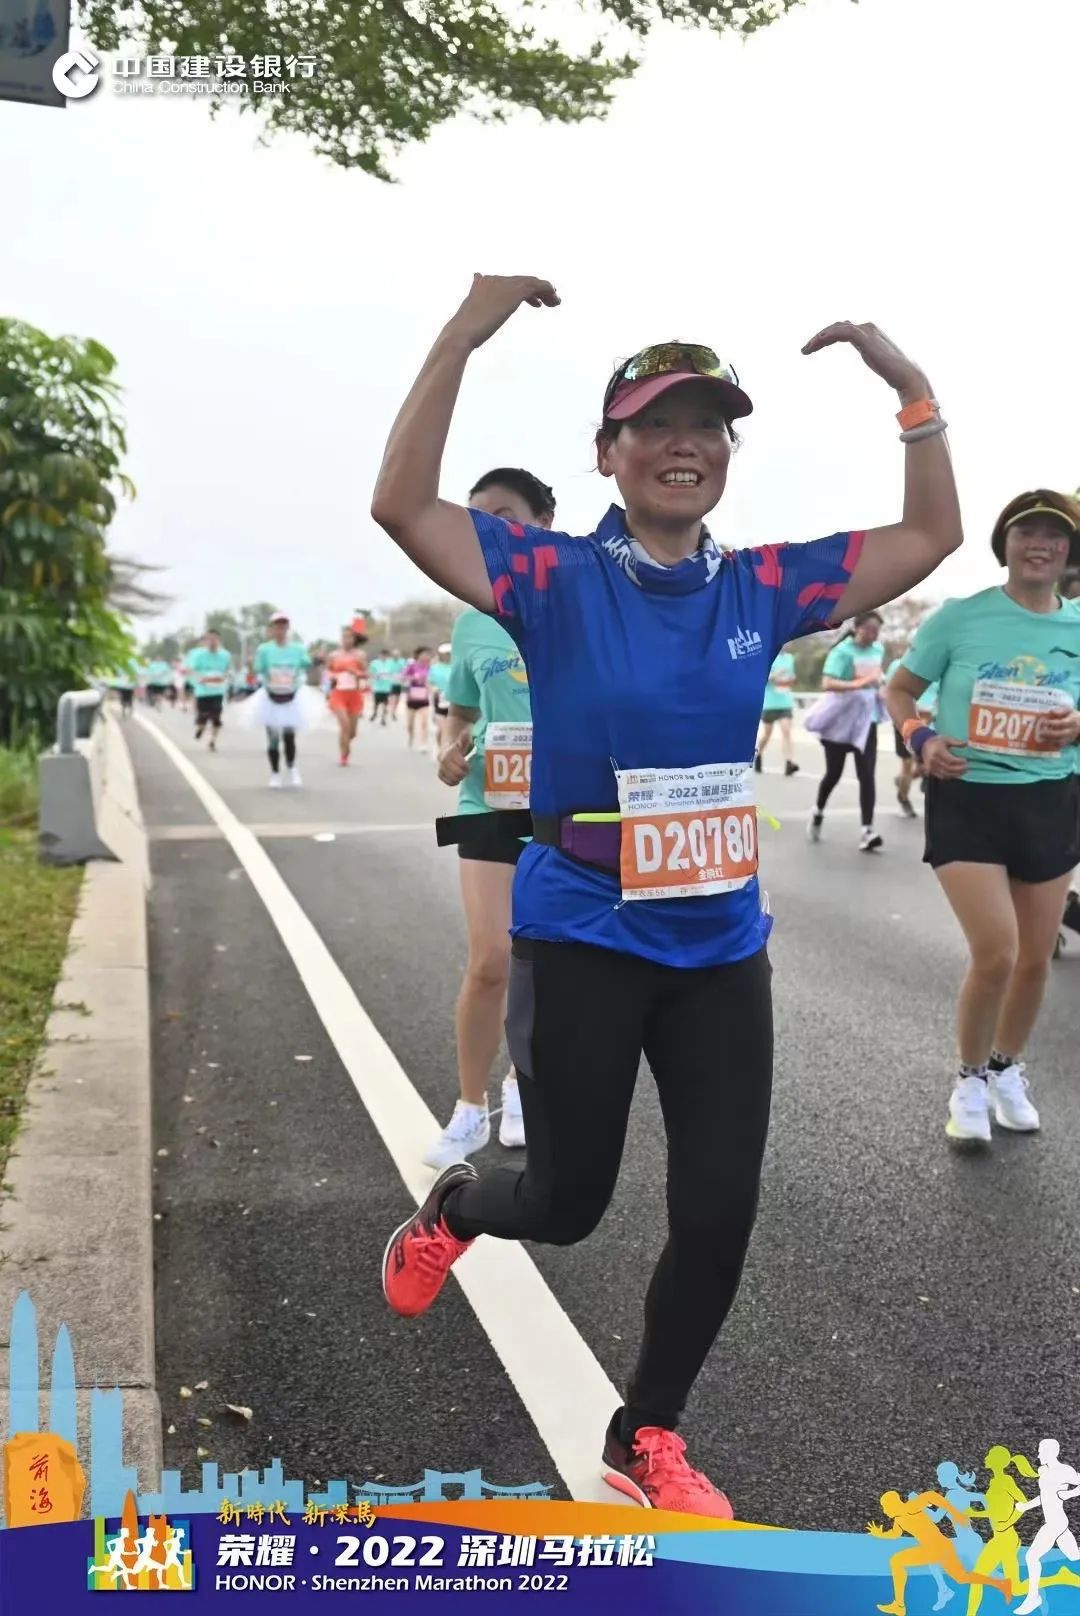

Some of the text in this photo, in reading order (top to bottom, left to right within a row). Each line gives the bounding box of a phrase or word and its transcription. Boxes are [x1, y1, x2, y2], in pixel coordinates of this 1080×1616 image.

[668, 786, 698, 799] 2022
[628, 802, 657, 811] HONOR
[634, 814, 754, 873] D20780
